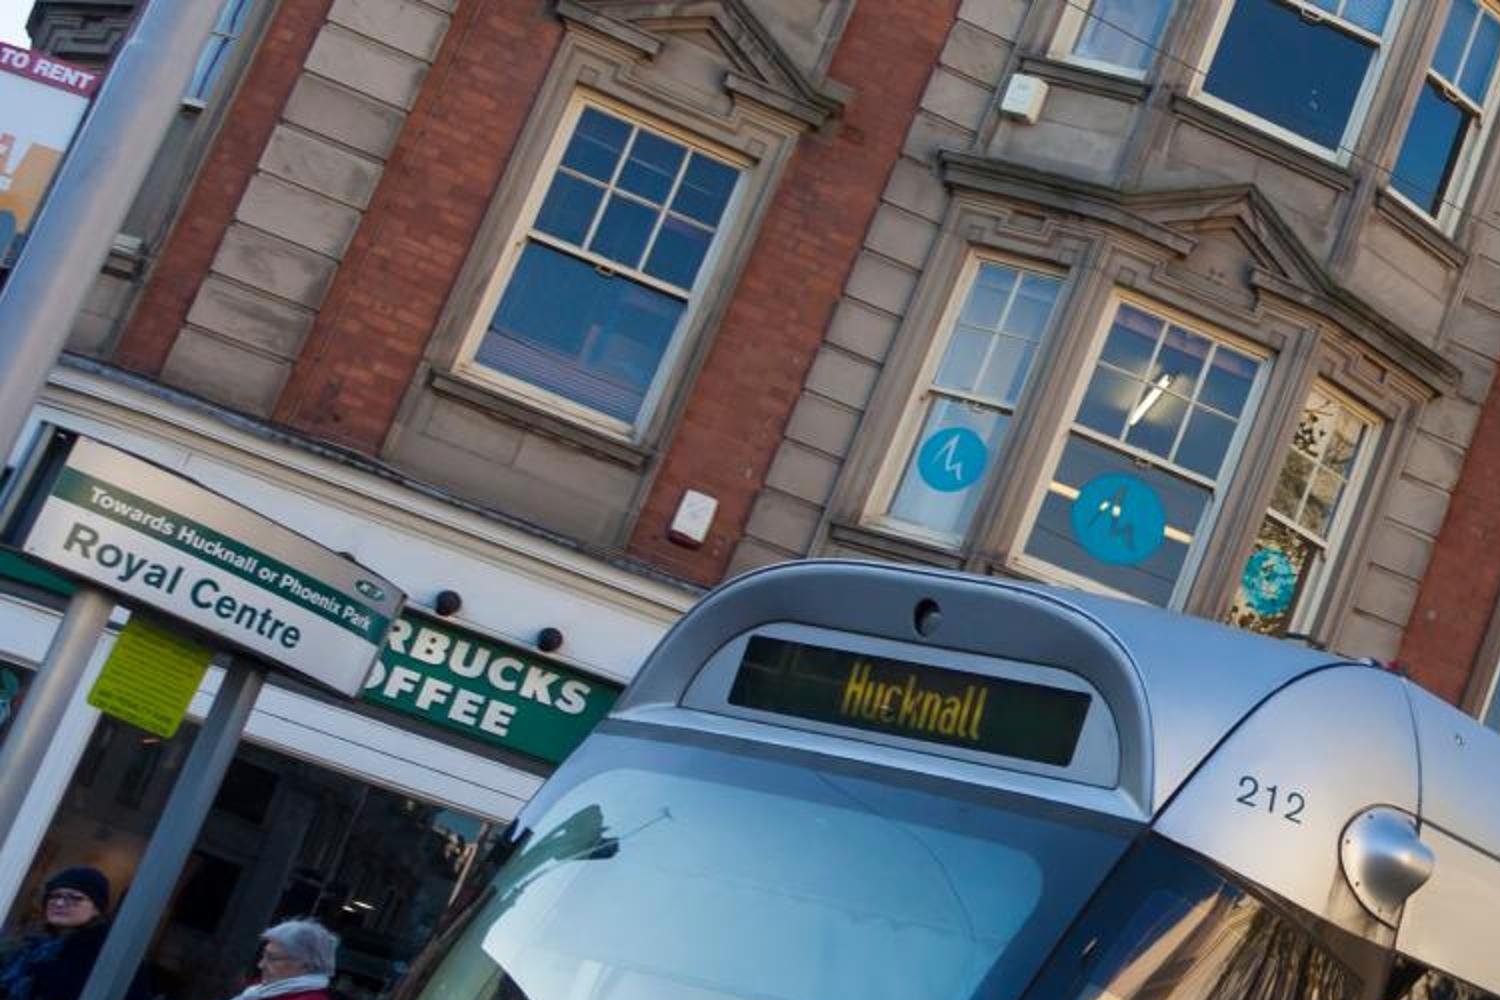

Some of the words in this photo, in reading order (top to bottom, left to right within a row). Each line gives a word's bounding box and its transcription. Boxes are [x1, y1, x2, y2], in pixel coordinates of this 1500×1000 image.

[1, 47, 31, 69] TO
[33, 57, 97, 89] RENT
[63, 521, 184, 595] Royal
[190, 578, 302, 648] Centre
[91, 486, 175, 535] Towards
[177, 525, 259, 574] Hucknall
[257, 566, 279, 583] or
[279, 573, 342, 614] Phoenix
[342, 606, 372, 632] Park
[840, 661, 989, 741] Hucknall
[1236, 775, 1305, 825] 212
